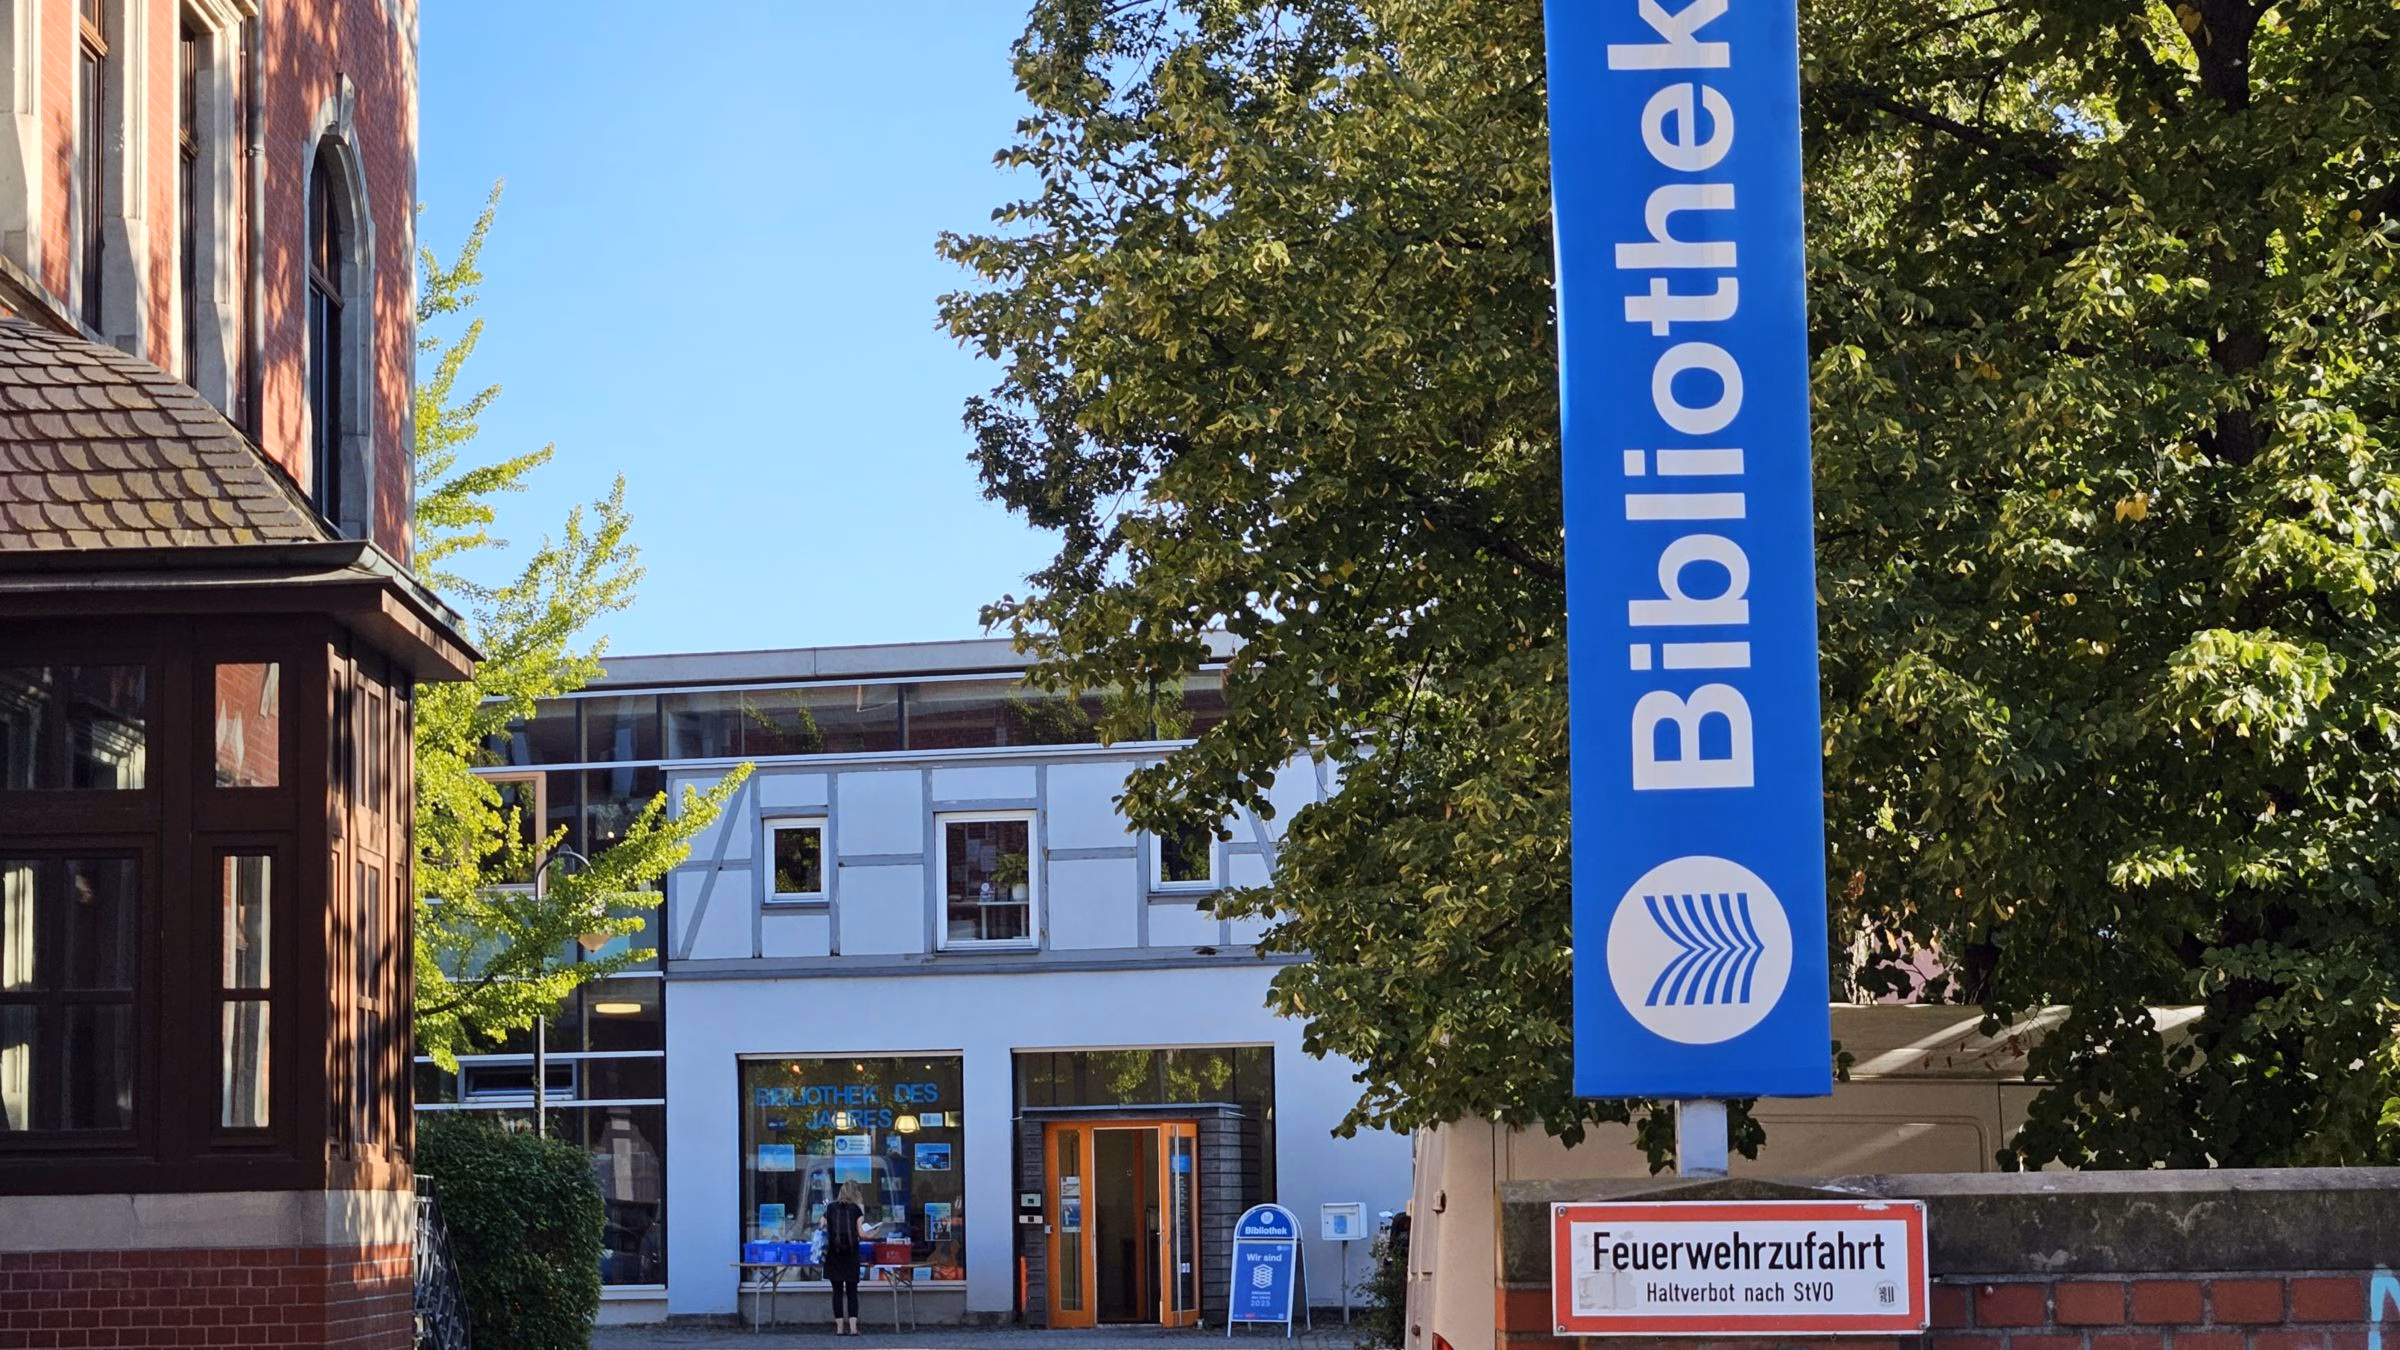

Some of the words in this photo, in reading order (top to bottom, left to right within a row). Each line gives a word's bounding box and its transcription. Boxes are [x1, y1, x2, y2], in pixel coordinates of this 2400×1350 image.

[1607, 0, 1755, 791] Bibliothek
[756, 1084, 878, 1107] BIBLIOTHEK
[894, 1083, 938, 1103] DES
[806, 1109, 892, 1130] JAHRES
[1245, 1226, 1287, 1235] Bibliothek
[1246, 1253, 1261, 1261] Wir
[1263, 1253, 1282, 1262] sind
[1593, 1231, 1885, 1271] Feuerwehrzufahrt
[1647, 1282, 1735, 1302] Haltverbot
[1745, 1282, 1784, 1302] nach
[1794, 1282, 1834, 1302] StVO
